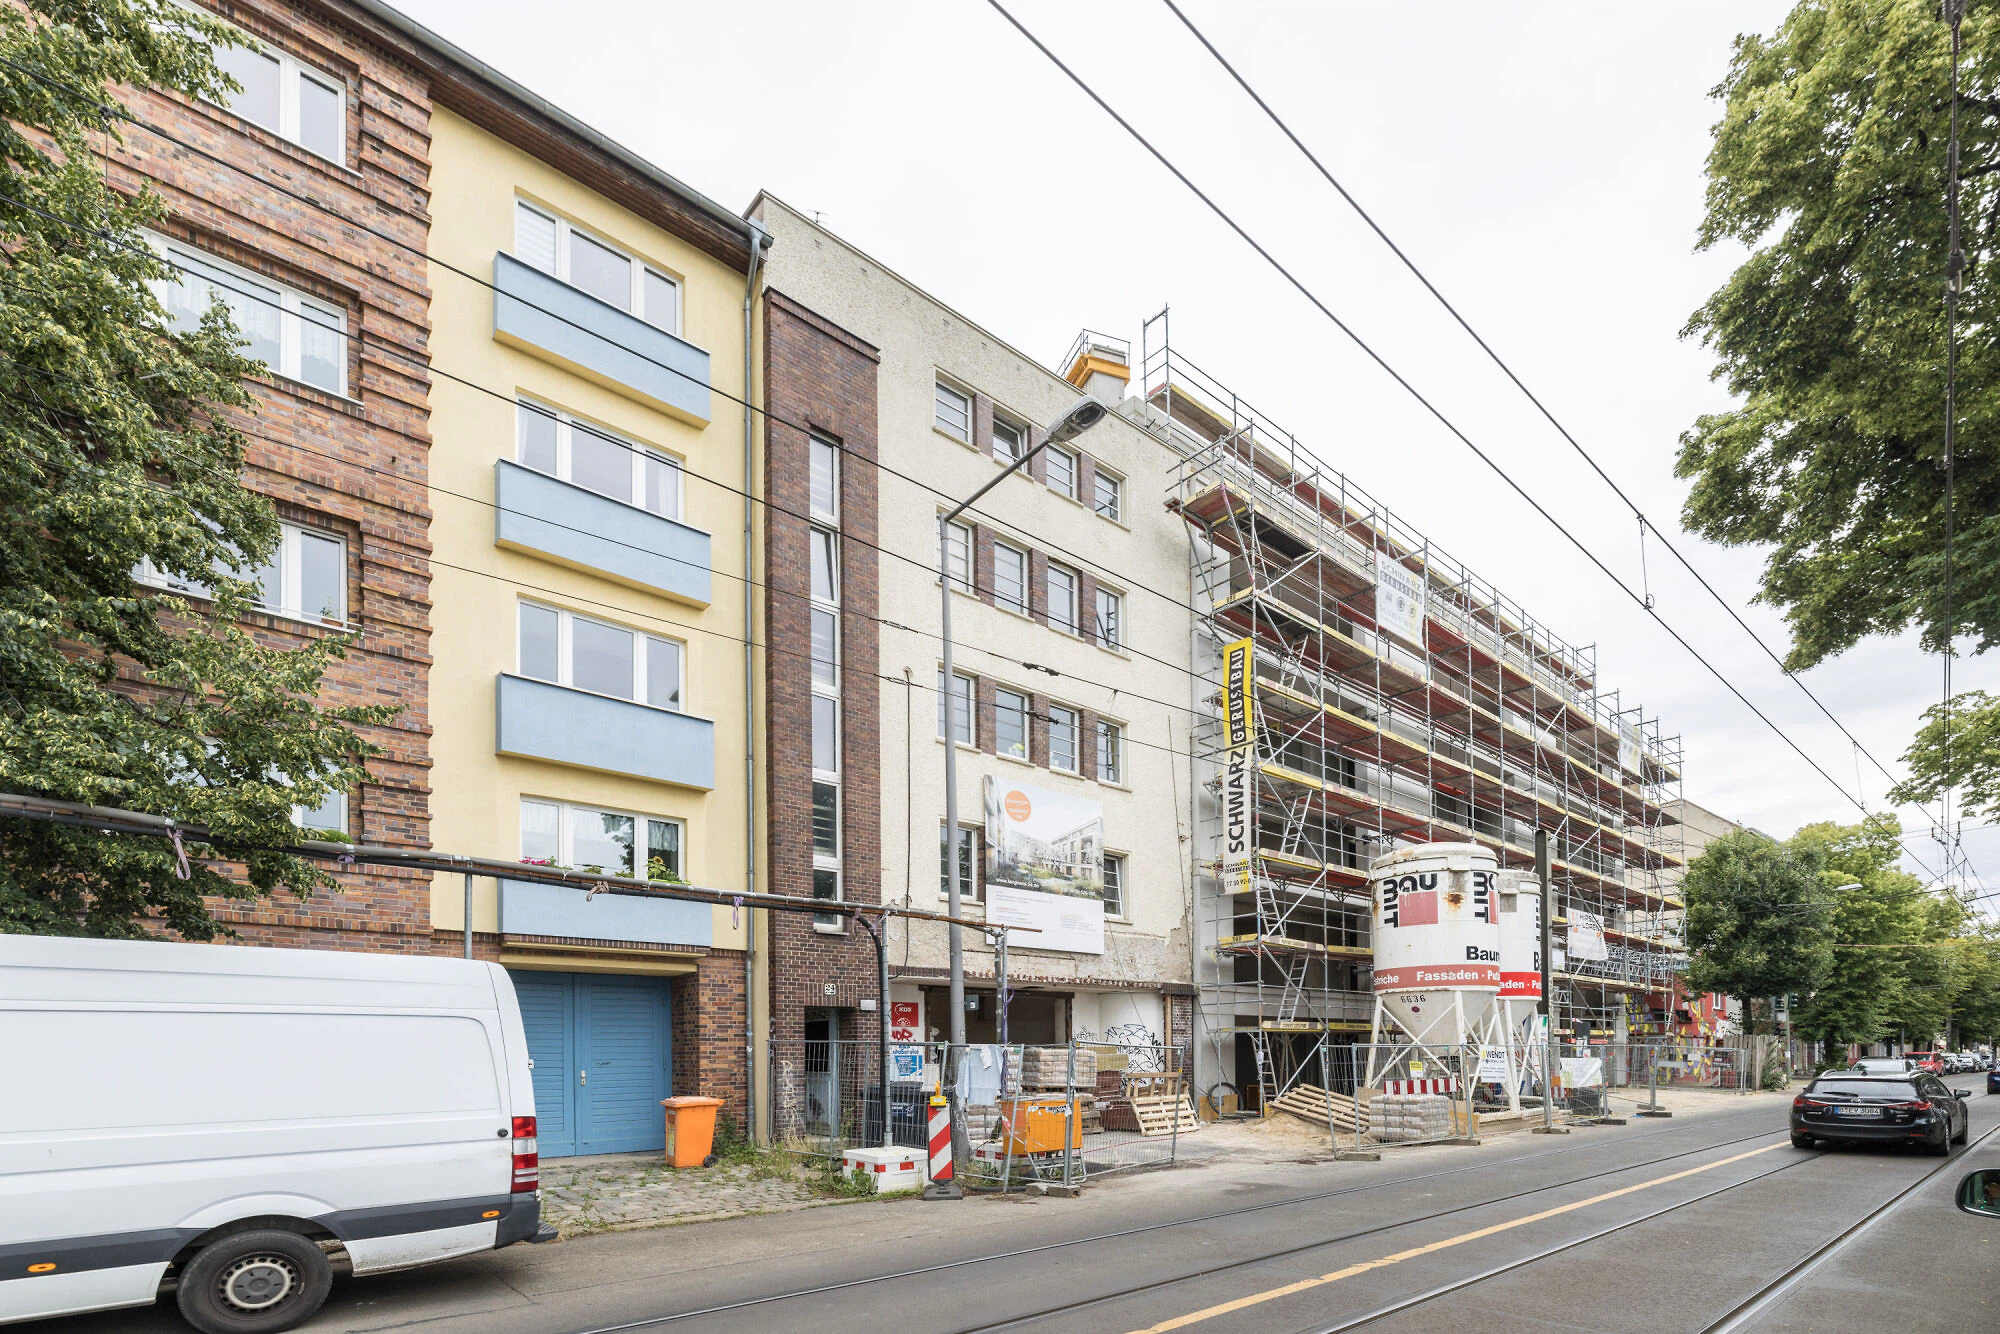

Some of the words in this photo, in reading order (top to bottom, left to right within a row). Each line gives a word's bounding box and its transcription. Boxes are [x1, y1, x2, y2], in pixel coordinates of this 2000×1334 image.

[1381, 561, 1421, 592] SCHWARZ
[1230, 649, 1245, 741] GERÜSTBAU
[1228, 747, 1247, 854] SCHWARZ
[1416, 970, 1478, 982] Fassaden
[1499, 980, 1524, 989] aden
[1486, 1050, 1505, 1059] WENDT
